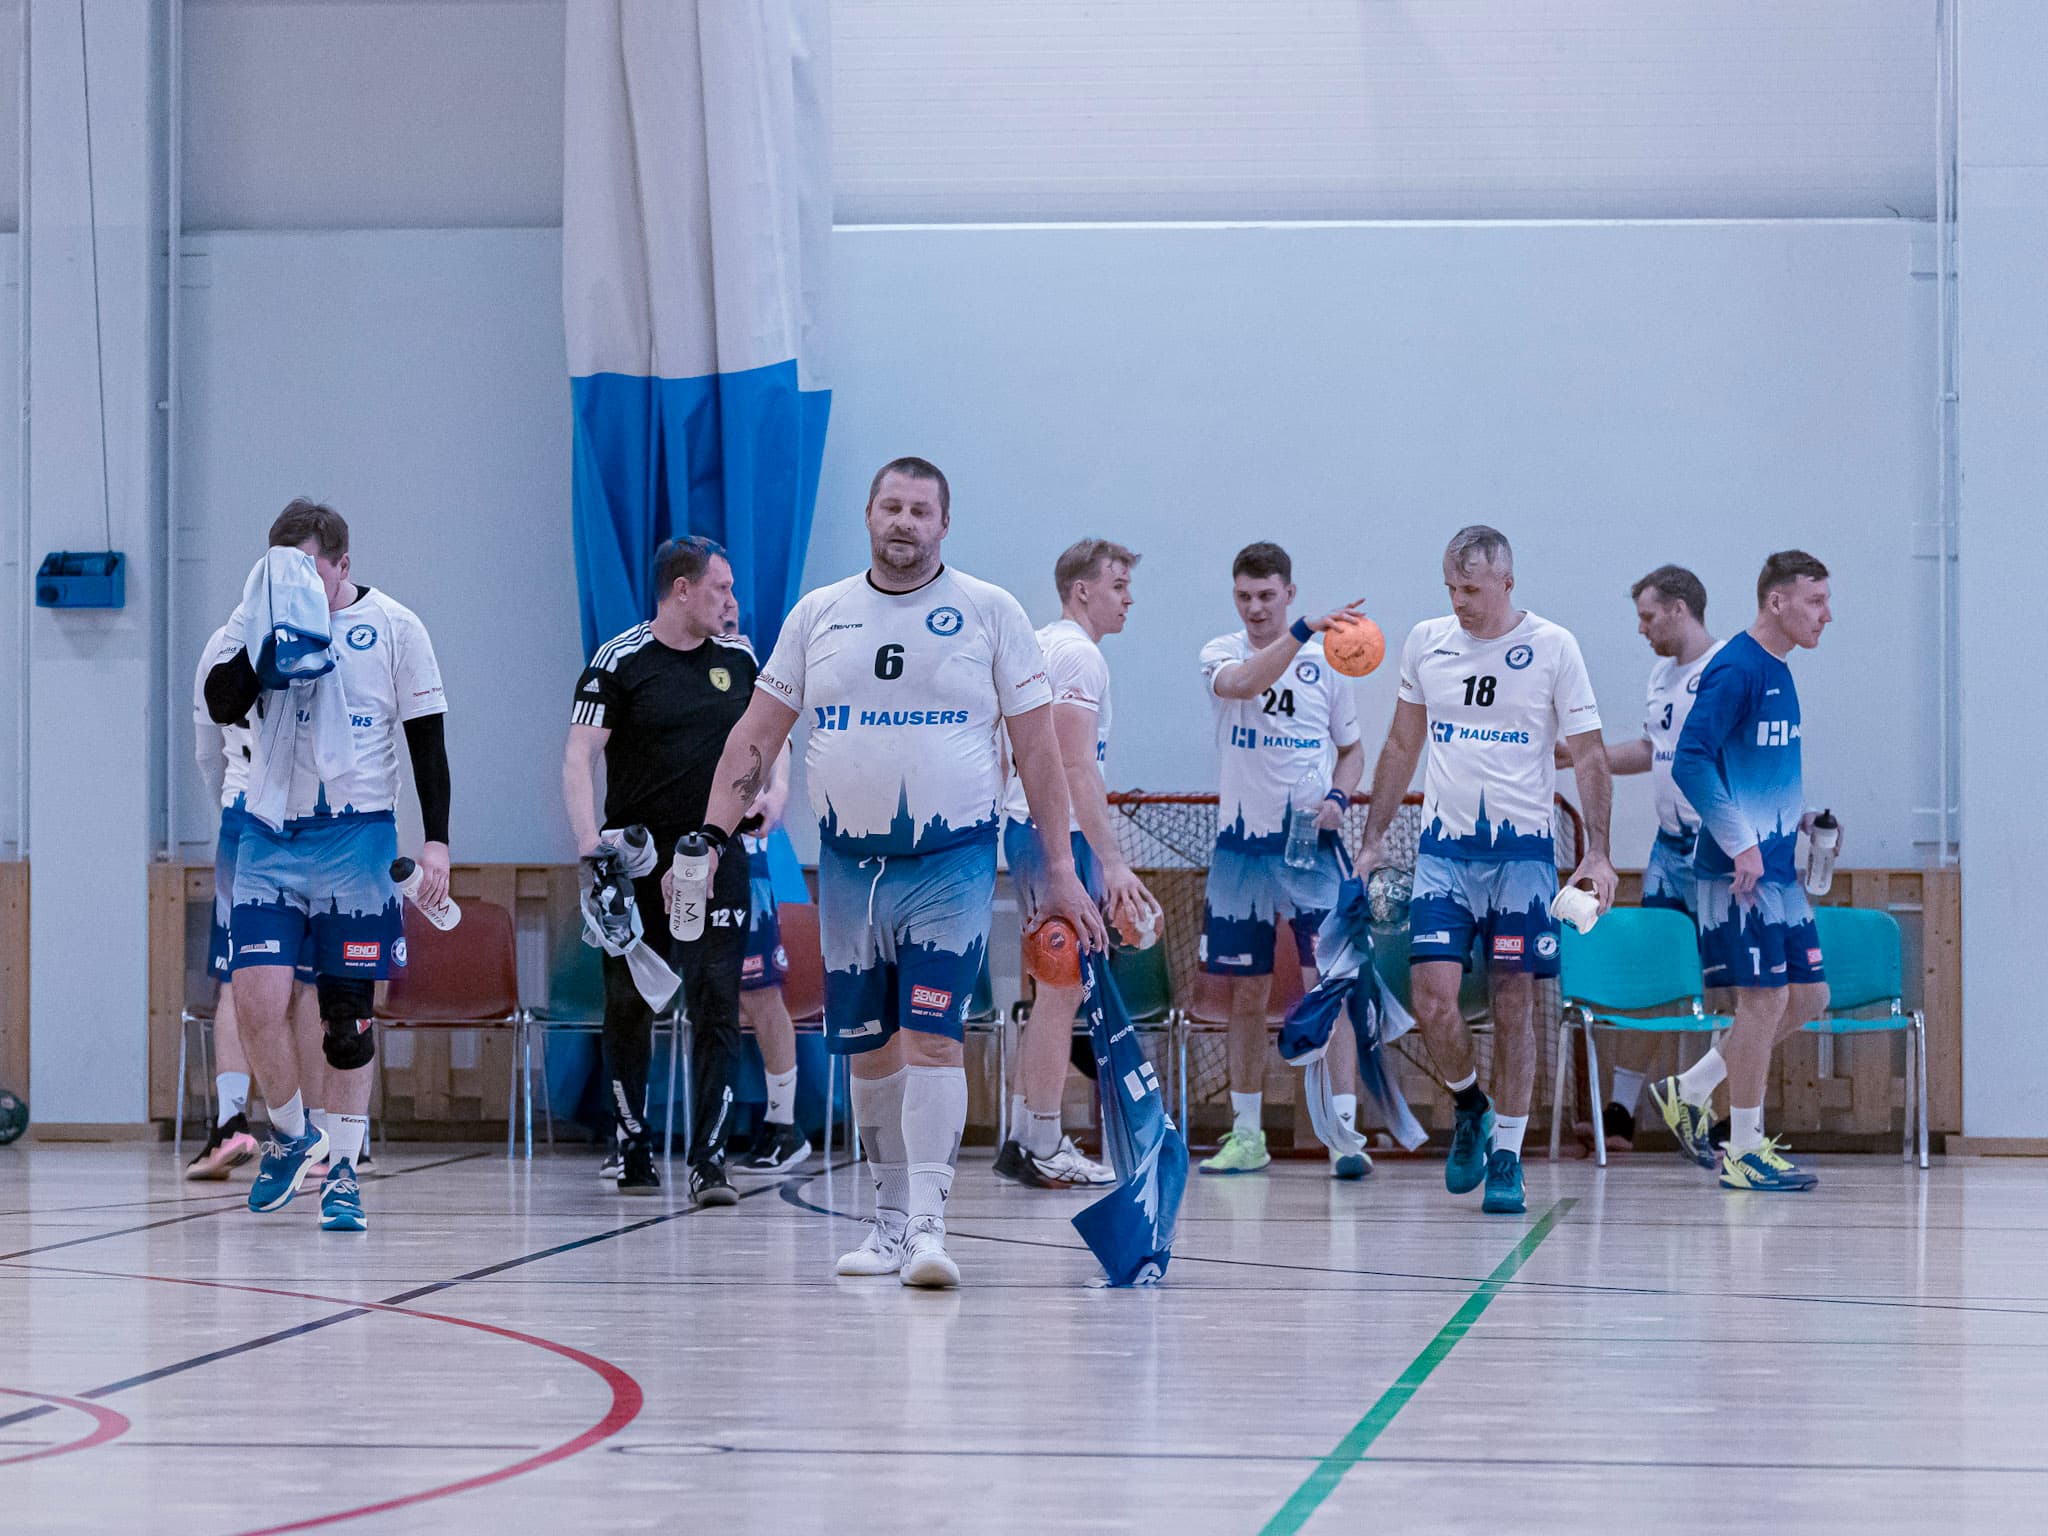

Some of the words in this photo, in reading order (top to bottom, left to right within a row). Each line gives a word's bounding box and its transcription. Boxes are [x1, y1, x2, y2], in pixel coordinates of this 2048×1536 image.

[874, 644, 905, 680] 6
[1261, 687, 1296, 717] 24
[1462, 675, 1497, 707] 18
[860, 710, 969, 726] HAUSERS
[1661, 703, 1673, 730] 3
[1460, 727, 1529, 744] HAUSERS
[673, 888, 682, 932] MAURTEN
[710, 908, 730, 927] 12
[914, 988, 949, 1007] SENCO
